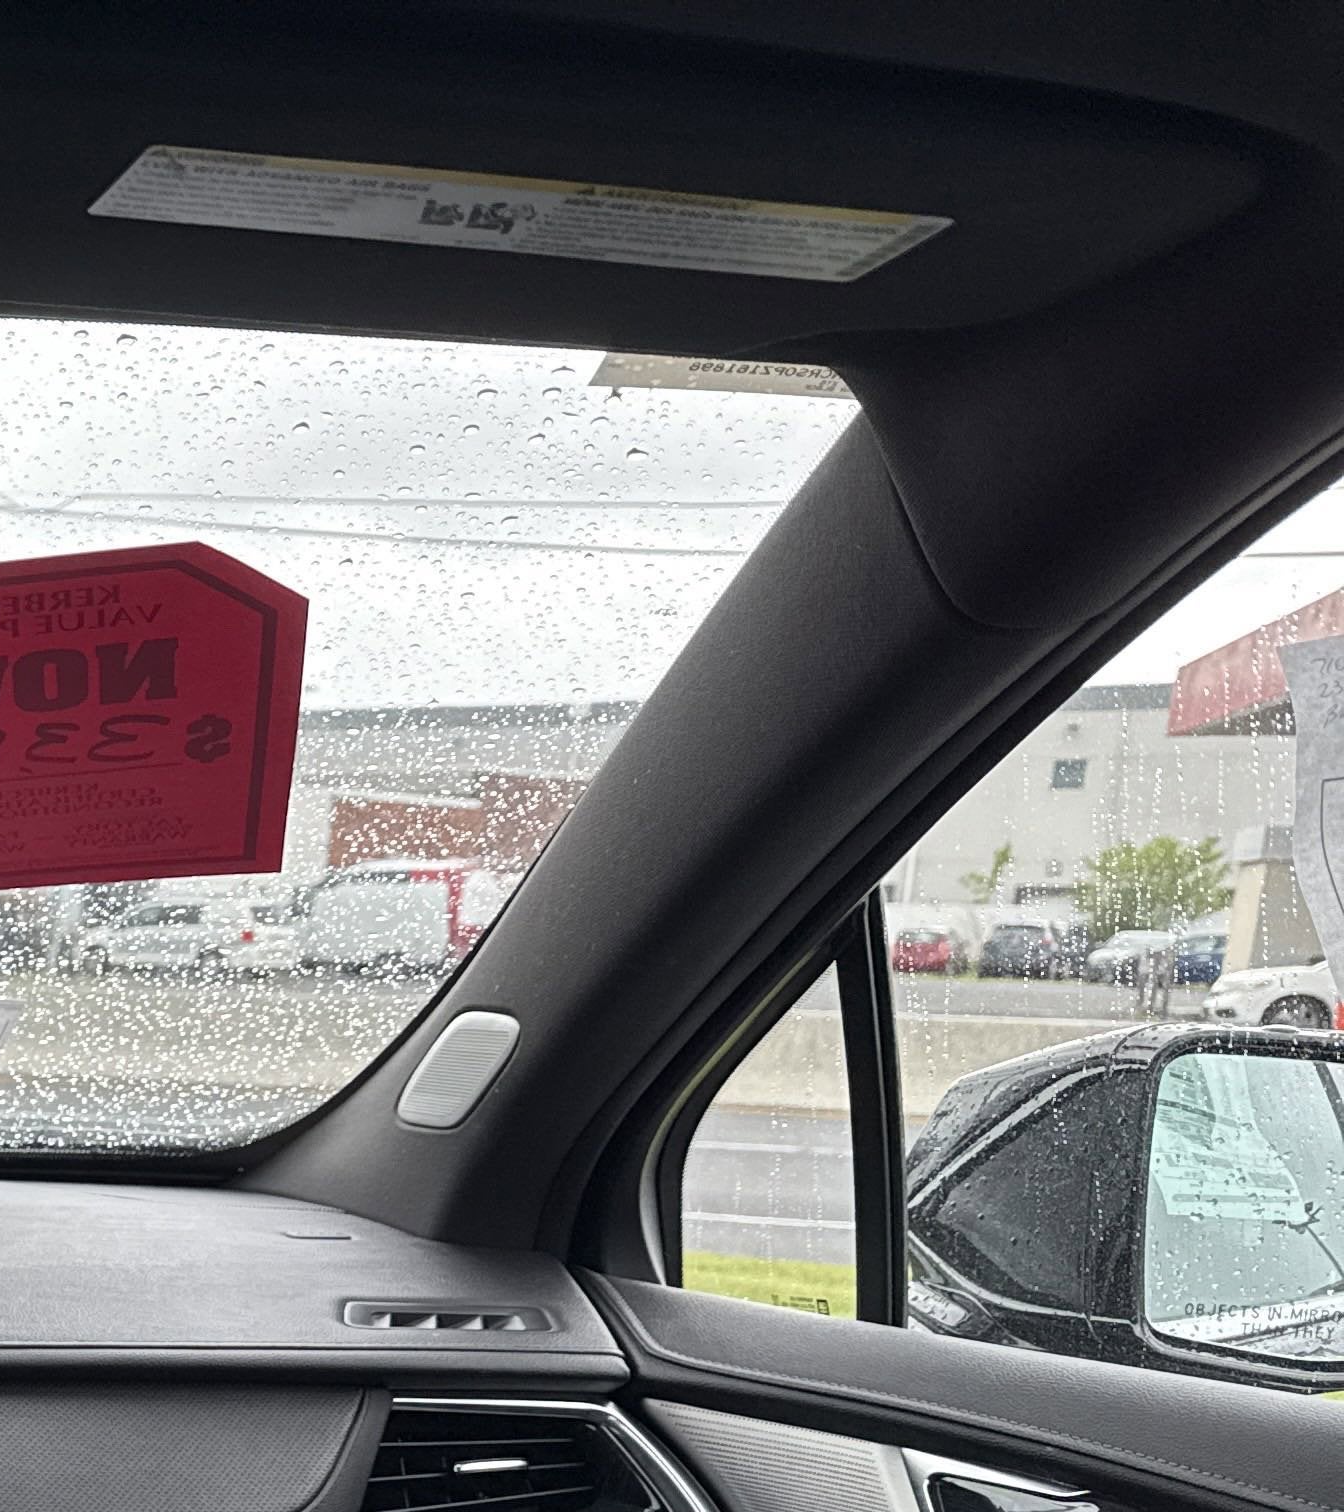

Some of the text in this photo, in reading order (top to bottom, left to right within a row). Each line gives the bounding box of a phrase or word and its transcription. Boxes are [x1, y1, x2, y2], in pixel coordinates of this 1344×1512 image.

[1184, 1303, 1261, 1318] OBJECTS
[1268, 1307, 1283, 1321] IN
[1242, 1322, 1336, 1340] THAN THEY
